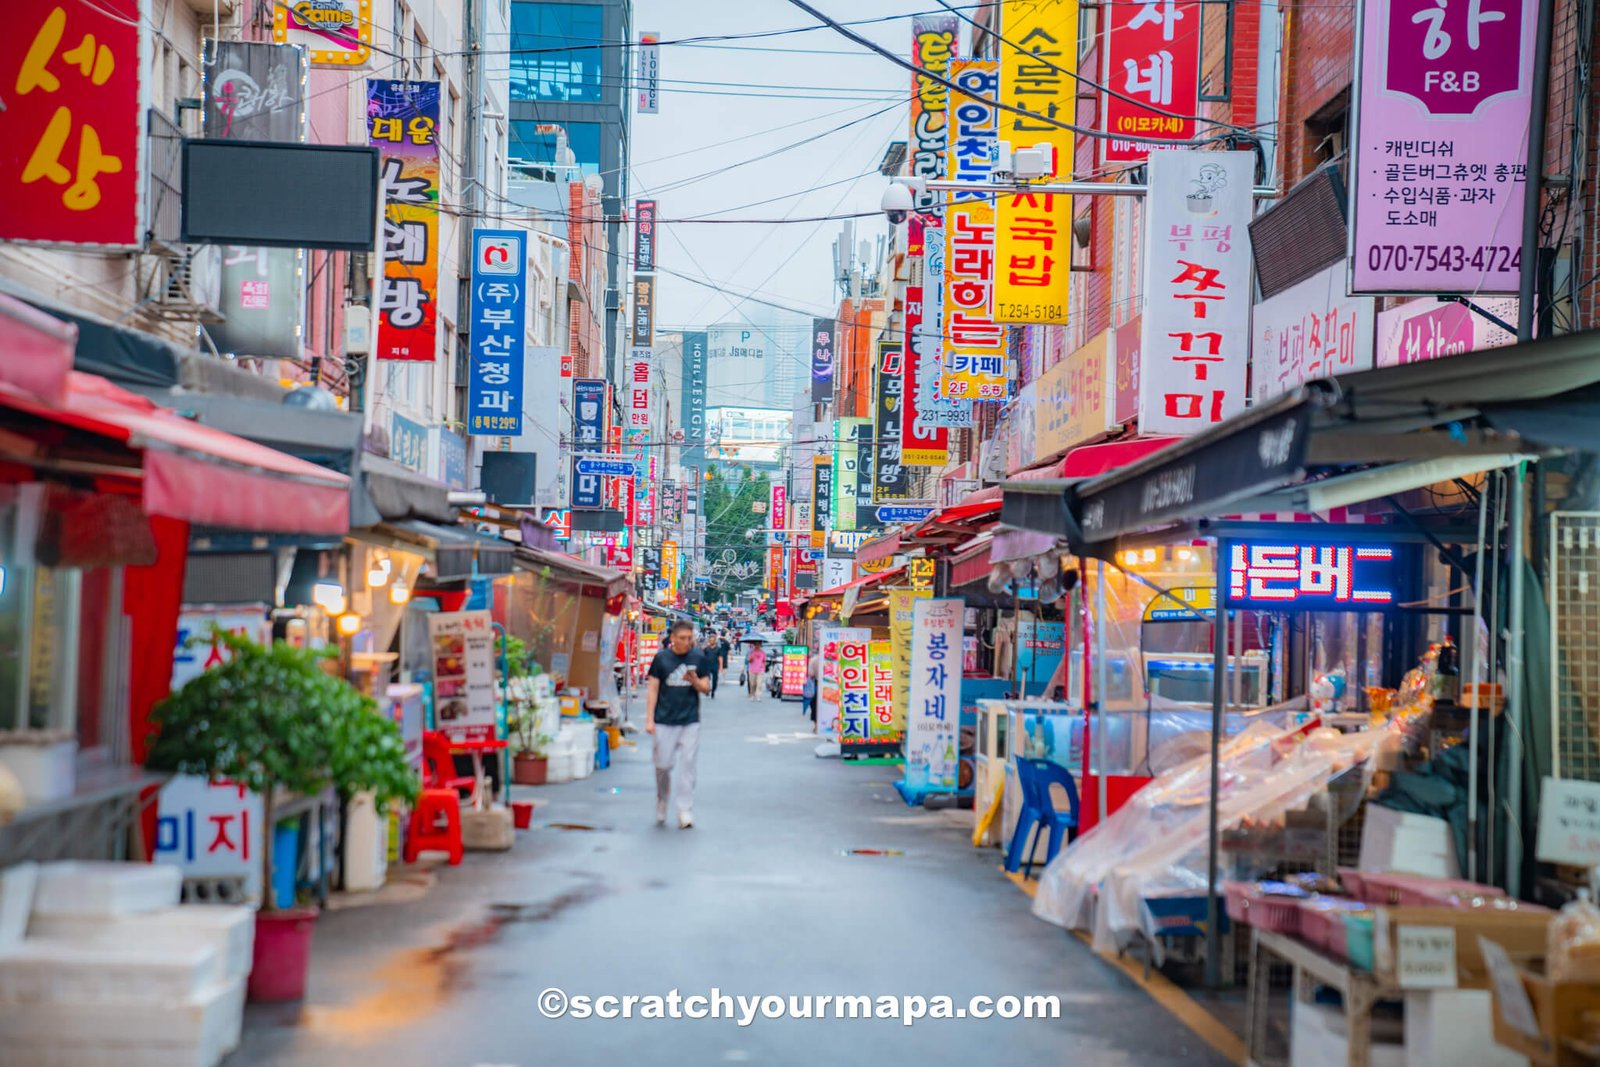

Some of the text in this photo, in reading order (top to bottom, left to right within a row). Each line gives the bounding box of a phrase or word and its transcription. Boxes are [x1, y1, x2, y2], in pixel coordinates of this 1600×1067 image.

[293, 2, 354, 25] Game
[649, 50, 657, 109] LOUNGE
[1013, 27, 1063, 132] 소문난
[1424, 71, 1480, 93] F&B
[15, 6, 123, 211] 세상
[372, 117, 435, 145] 대운
[1117, 116, 1184, 133] (이모카세)
[1385, 140, 1454, 158] 캐빈디쉬
[1385, 163, 1527, 182] 골든버그츄엣 총판
[1384, 187, 1496, 205] 수입식품·과자
[1385, 211, 1437, 227] 도소매
[381, 158, 432, 328] 노래방
[1168, 224, 1232, 254] 부평
[391, 348, 410, 356] 지하
[477, 282, 519, 413] (주)부산청과
[693, 343, 702, 375] HOTEL
[816, 331, 831, 362] 루나
[955, 356, 1002, 375] 카페
[950, 381, 968, 393] 2F
[632, 413, 649, 425] 만원
[921, 410, 971, 422] 231-9931
[880, 421, 903, 483] 노래방
[924, 632, 949, 721] 봉자네
[842, 643, 868, 738] 여인천지
